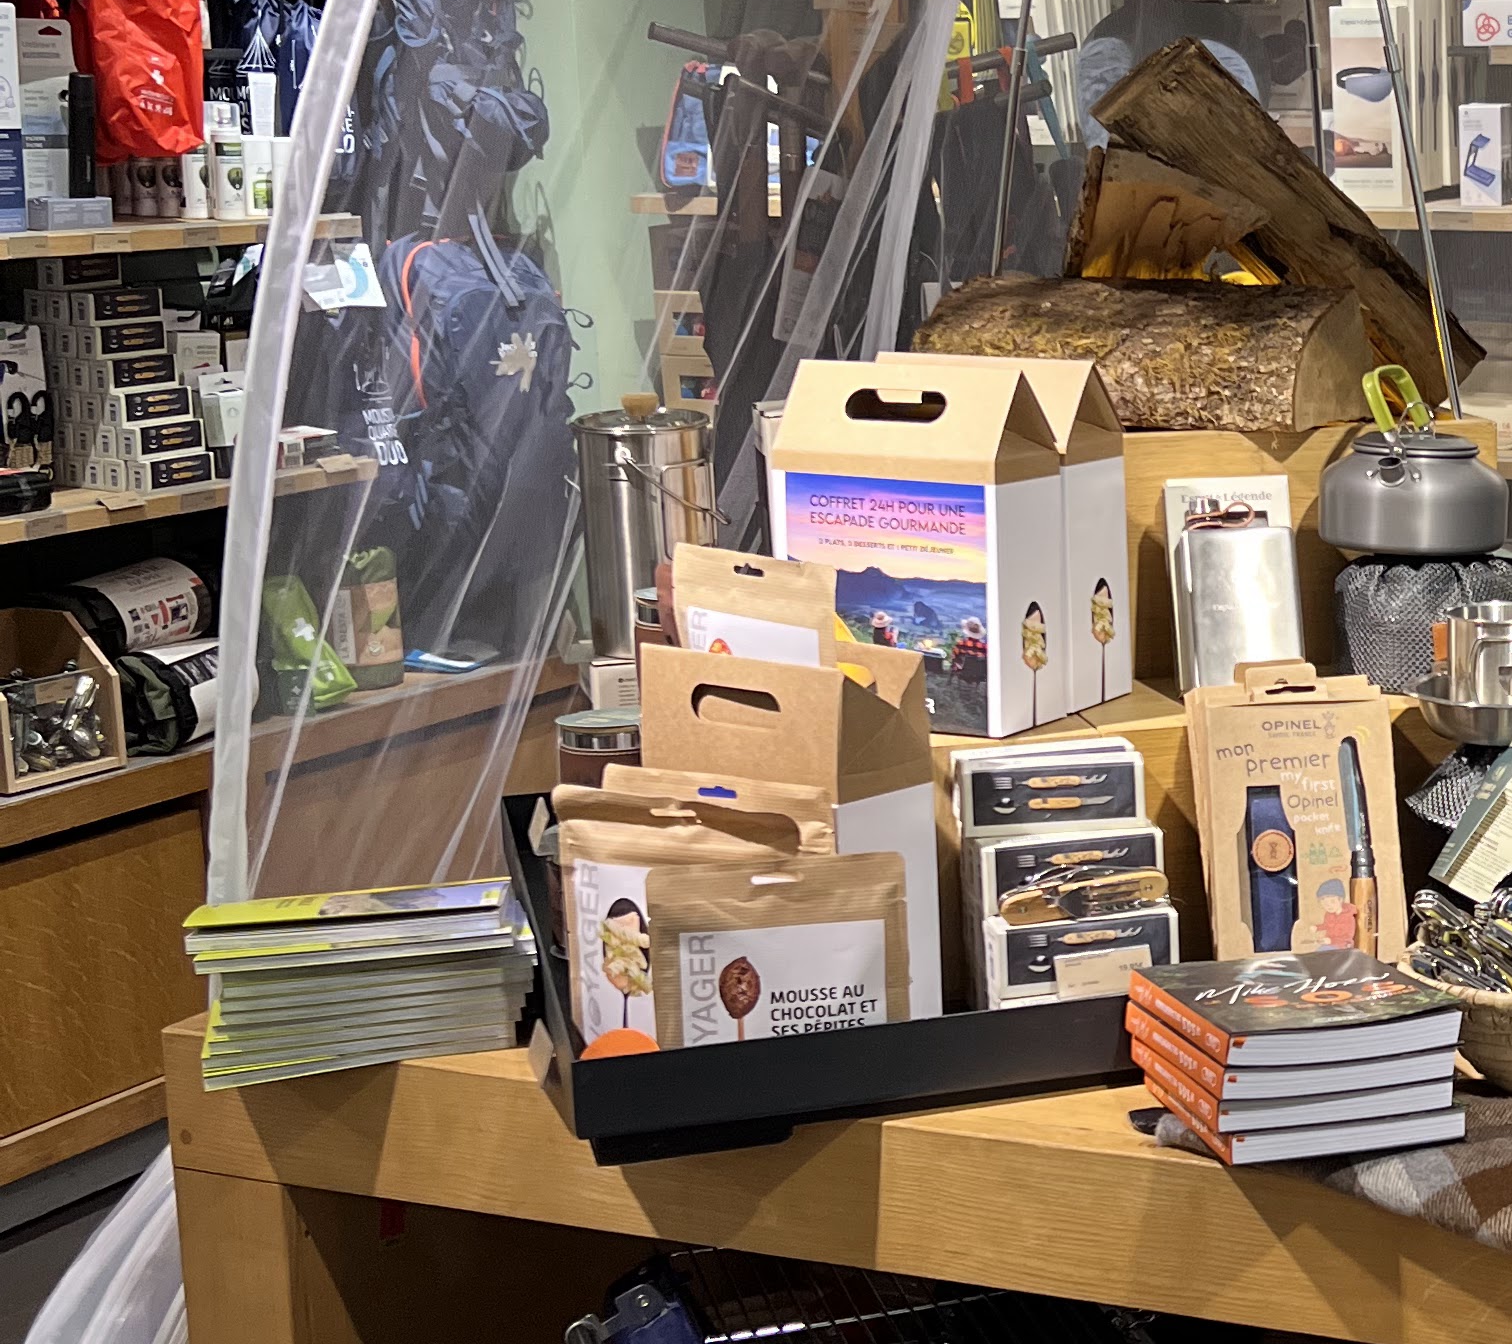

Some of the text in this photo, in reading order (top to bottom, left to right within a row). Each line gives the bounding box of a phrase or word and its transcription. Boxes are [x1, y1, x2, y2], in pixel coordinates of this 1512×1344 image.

[374, 441, 408, 466] DUO
[810, 494, 966, 518] COFFRET 24H POUR UNE
[1224, 491, 1272, 503] Légende
[810, 511, 966, 536] ESCAPADE GOURMANDE
[1261, 720, 1321, 732] OPINEL
[1216, 743, 1254, 761] mon
[1246, 752, 1331, 776] premier
[1280, 770, 1302, 785] my
[1301, 778, 1336, 793] first
[1287, 793, 1339, 811] Opinel
[1293, 812, 1330, 824] pocket
[1315, 823, 1342, 835] knife
[686, 933, 719, 1044] YAGER
[770, 983, 865, 1005] MOUSSE AU
[770, 998, 878, 1022] CHOCOLAT ET
[770, 1013, 866, 1036] SES PÉPITES
